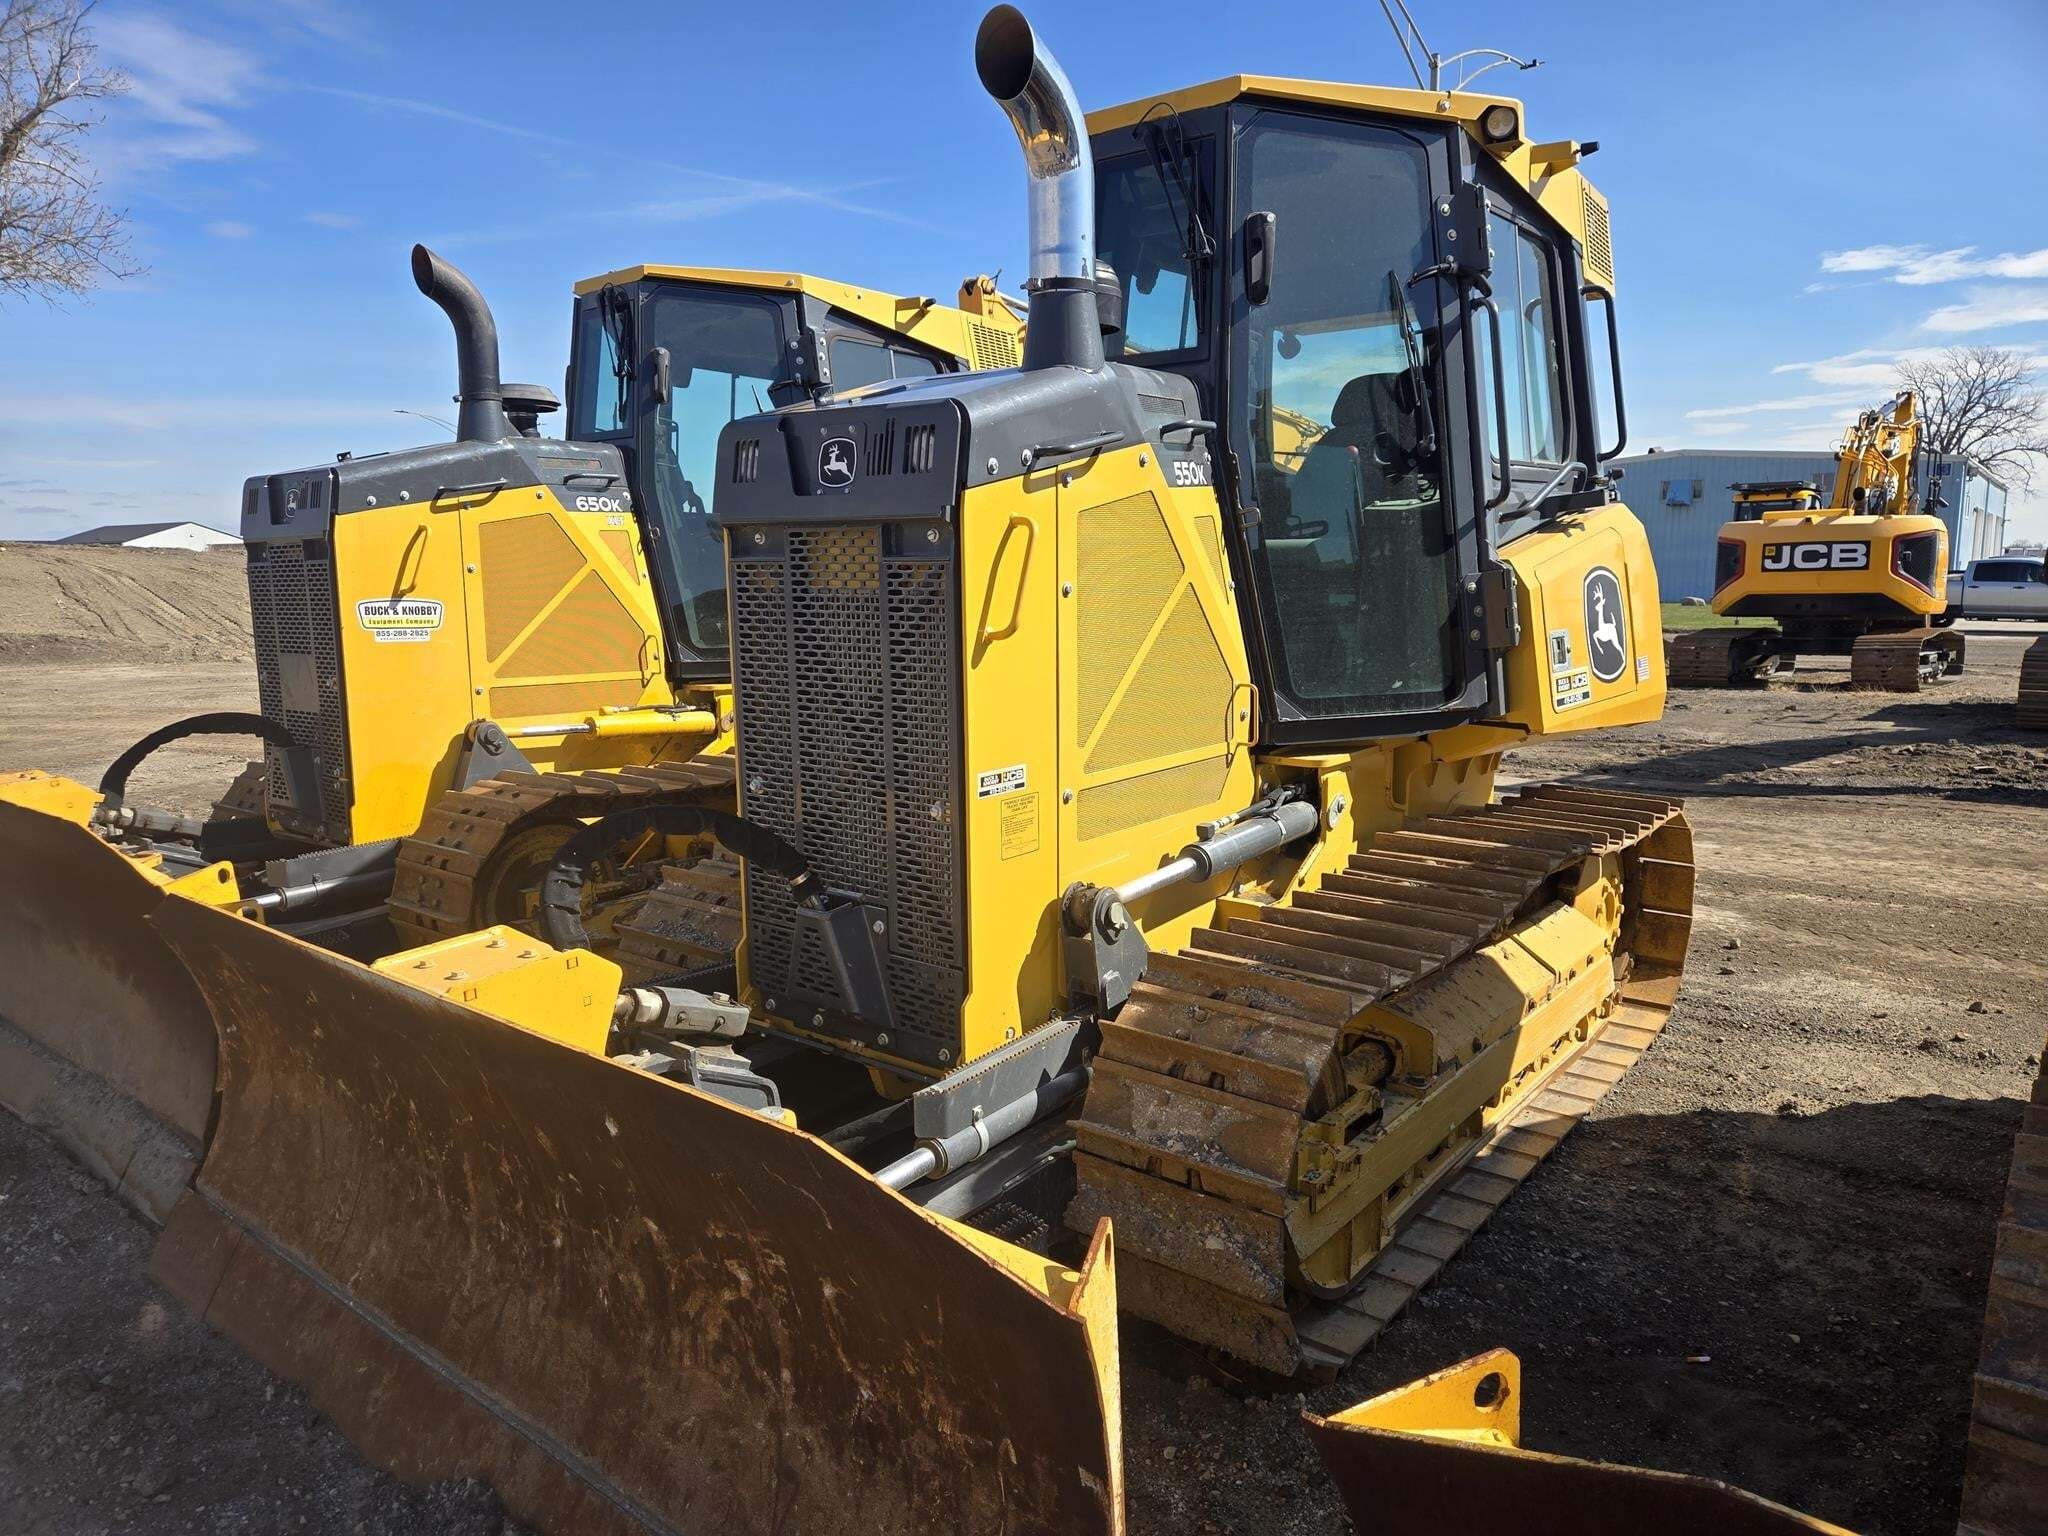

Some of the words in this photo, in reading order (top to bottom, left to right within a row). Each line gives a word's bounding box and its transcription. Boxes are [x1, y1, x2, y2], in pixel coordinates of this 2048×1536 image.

[1173, 461, 1207, 485] 550K
[576, 496, 623, 511] 650K
[1764, 543, 1867, 570] JCB
[364, 606, 389, 616] BUCK
[392, 608, 399, 616] &
[402, 606, 437, 616] KNOBBY
[1003, 769, 1024, 783] JCB
